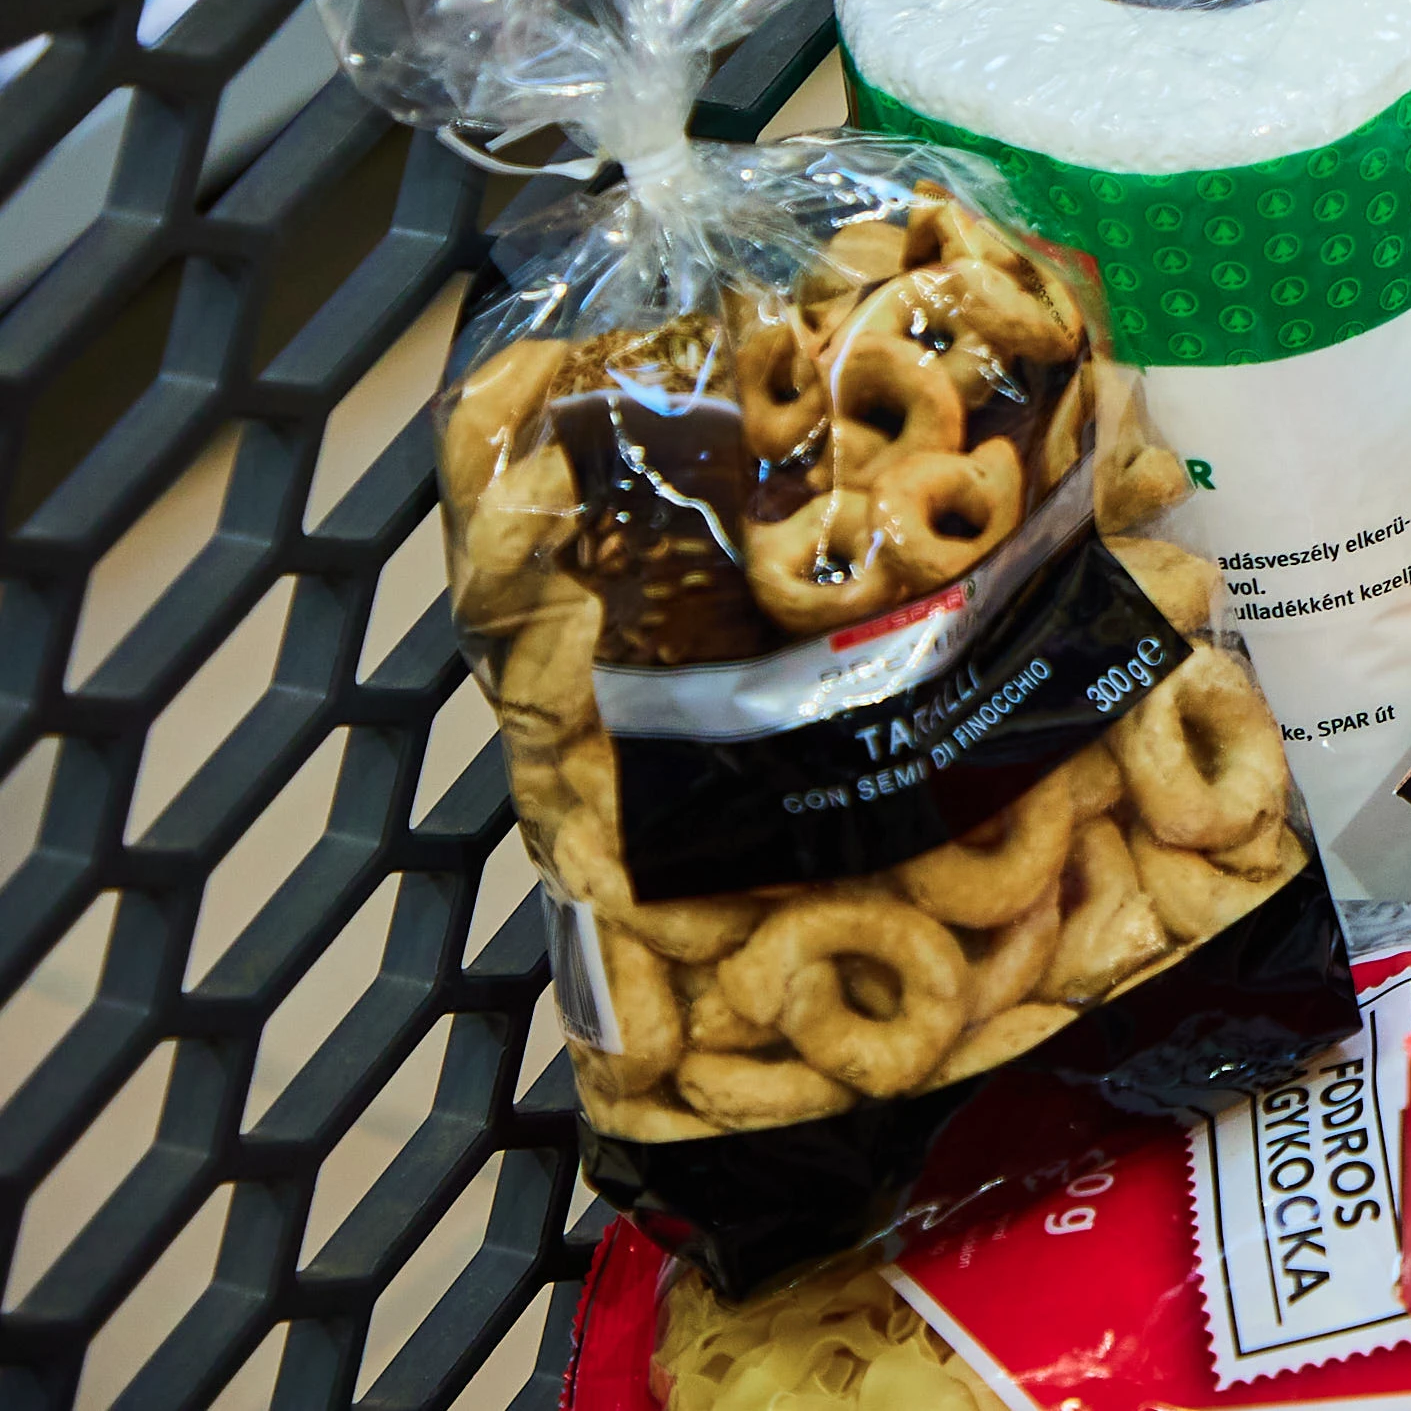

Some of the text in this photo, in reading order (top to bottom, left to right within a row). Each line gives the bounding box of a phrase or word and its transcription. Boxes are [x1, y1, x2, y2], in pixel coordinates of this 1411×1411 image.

[1218, 516, 1411, 571] adásveszély elkerü-
[1227, 577, 1266, 596] vol.
[1235, 589, 1354, 621] ulladékként
[855, 663, 984, 761] TARALLI
[1085, 658, 1155, 714] 300 g
[783, 657, 1053, 814] CON SEMI DI FINOCCHIO
[1281, 704, 1396, 742] ke, SPAR út
[1318, 1058, 1383, 1230] FODROS
[1044, 1206, 1096, 1235] g
